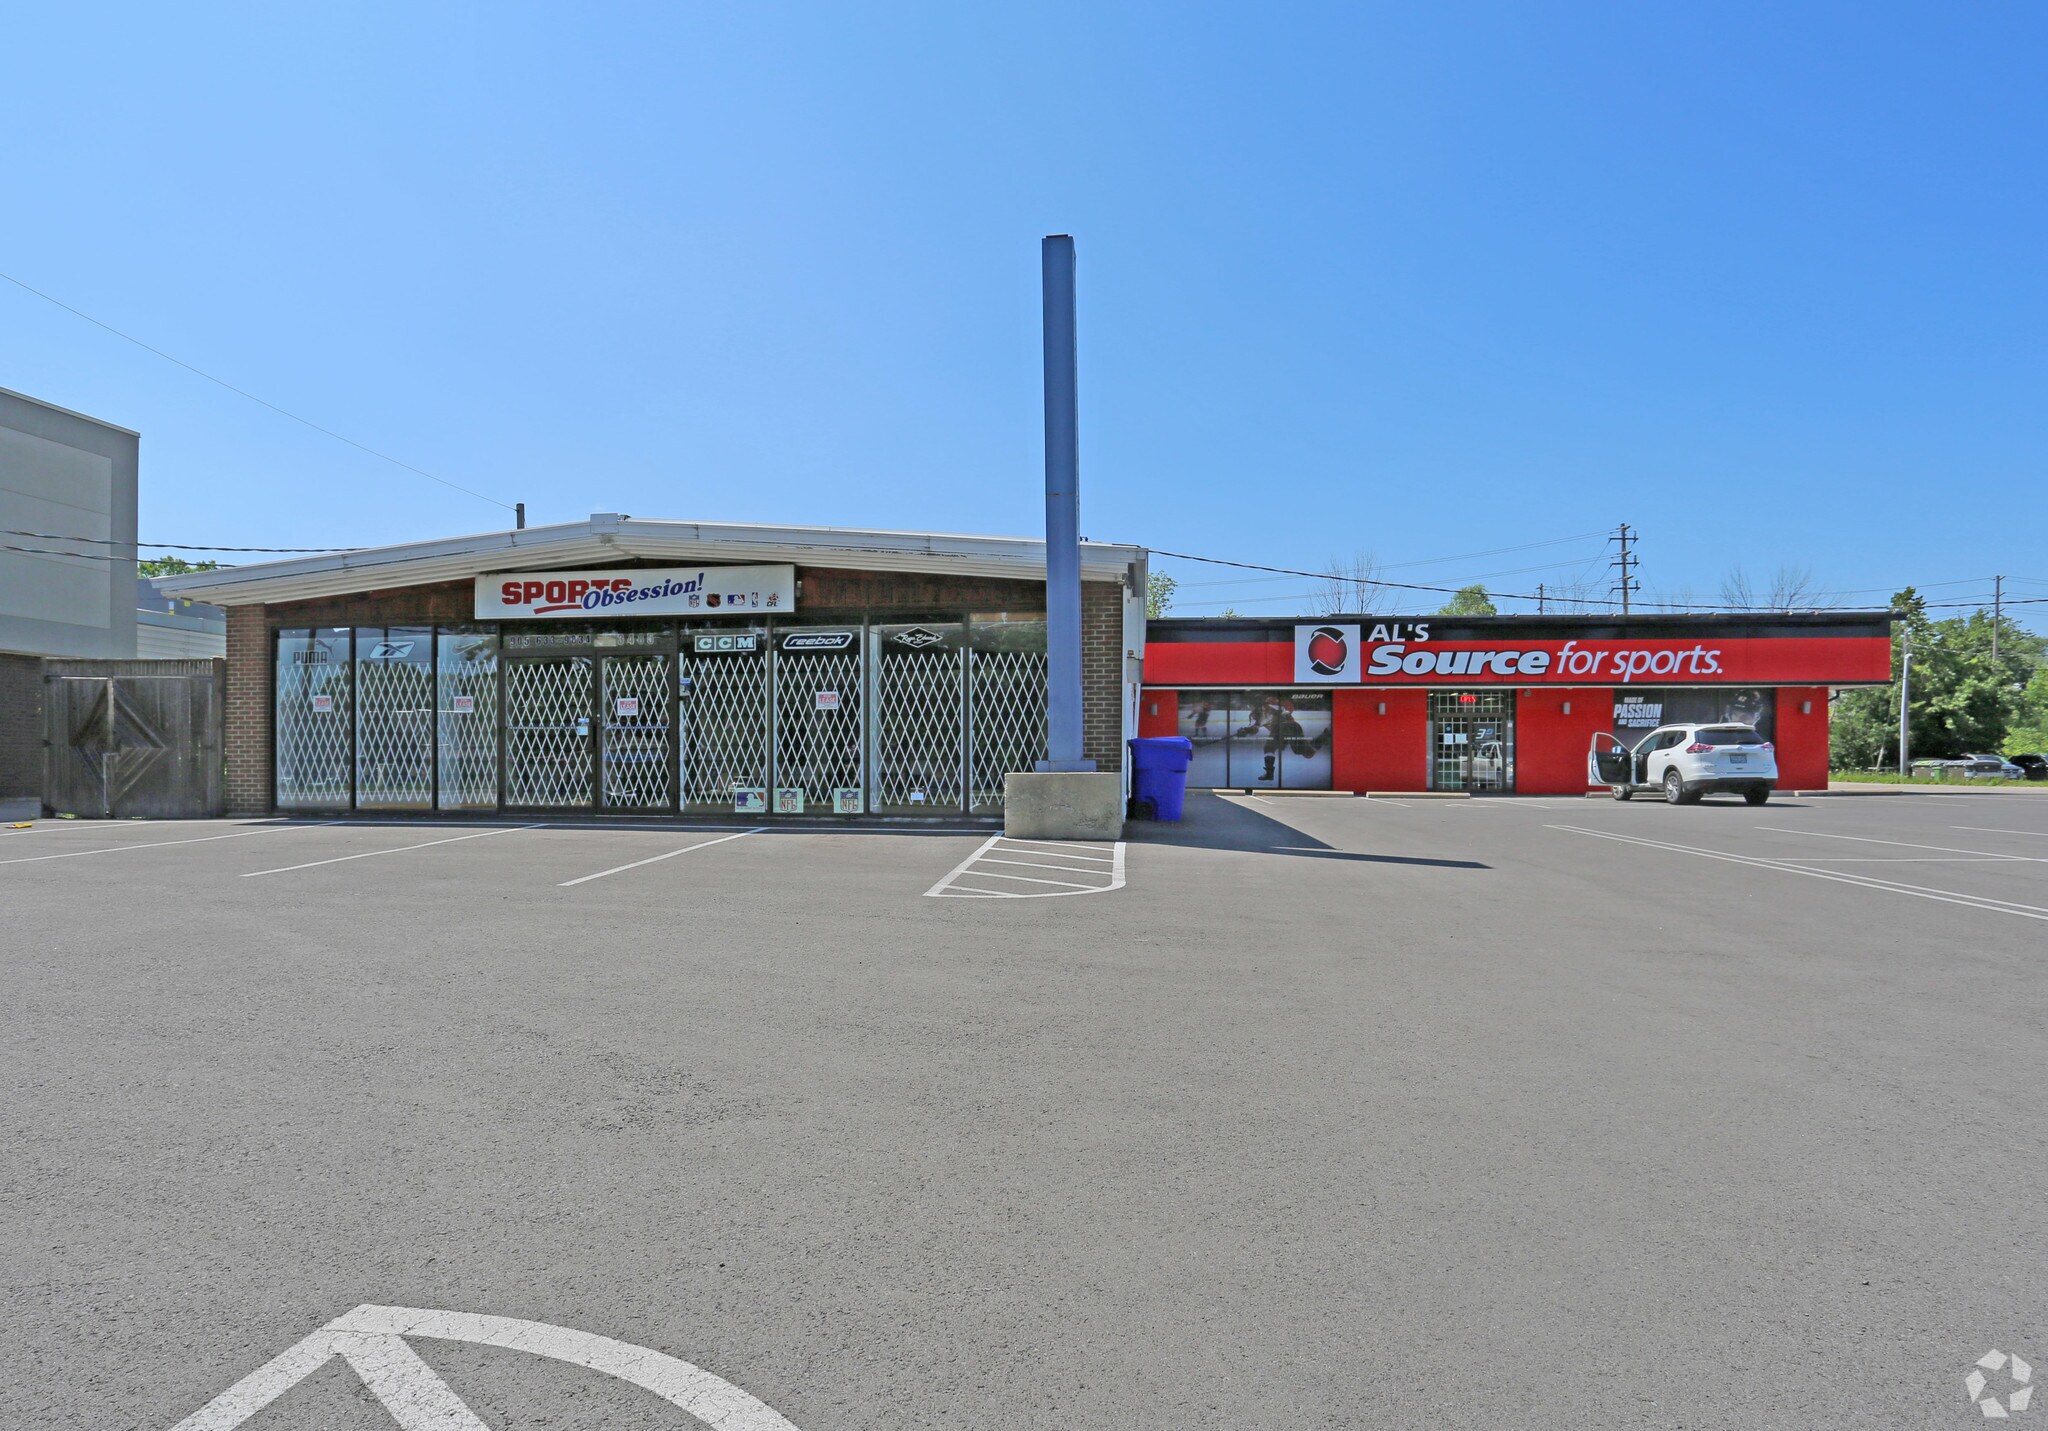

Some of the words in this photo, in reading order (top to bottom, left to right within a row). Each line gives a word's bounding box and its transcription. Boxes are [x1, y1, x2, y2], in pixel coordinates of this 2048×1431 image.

[502, 579, 632, 605] SPORTS
[583, 573, 704, 610] Obsession!
[1367, 624, 1430, 642] AL'S
[698, 637, 754, 649] CCM
[789, 636, 844, 646] reebok
[293, 651, 327, 664] PUMA
[1367, 644, 1550, 675] Source
[1557, 641, 1609, 674] for
[1610, 645, 1723, 682] sports.
[1613, 704, 1662, 718] PASSION
[1627, 719, 1660, 727] SACRIFICE
